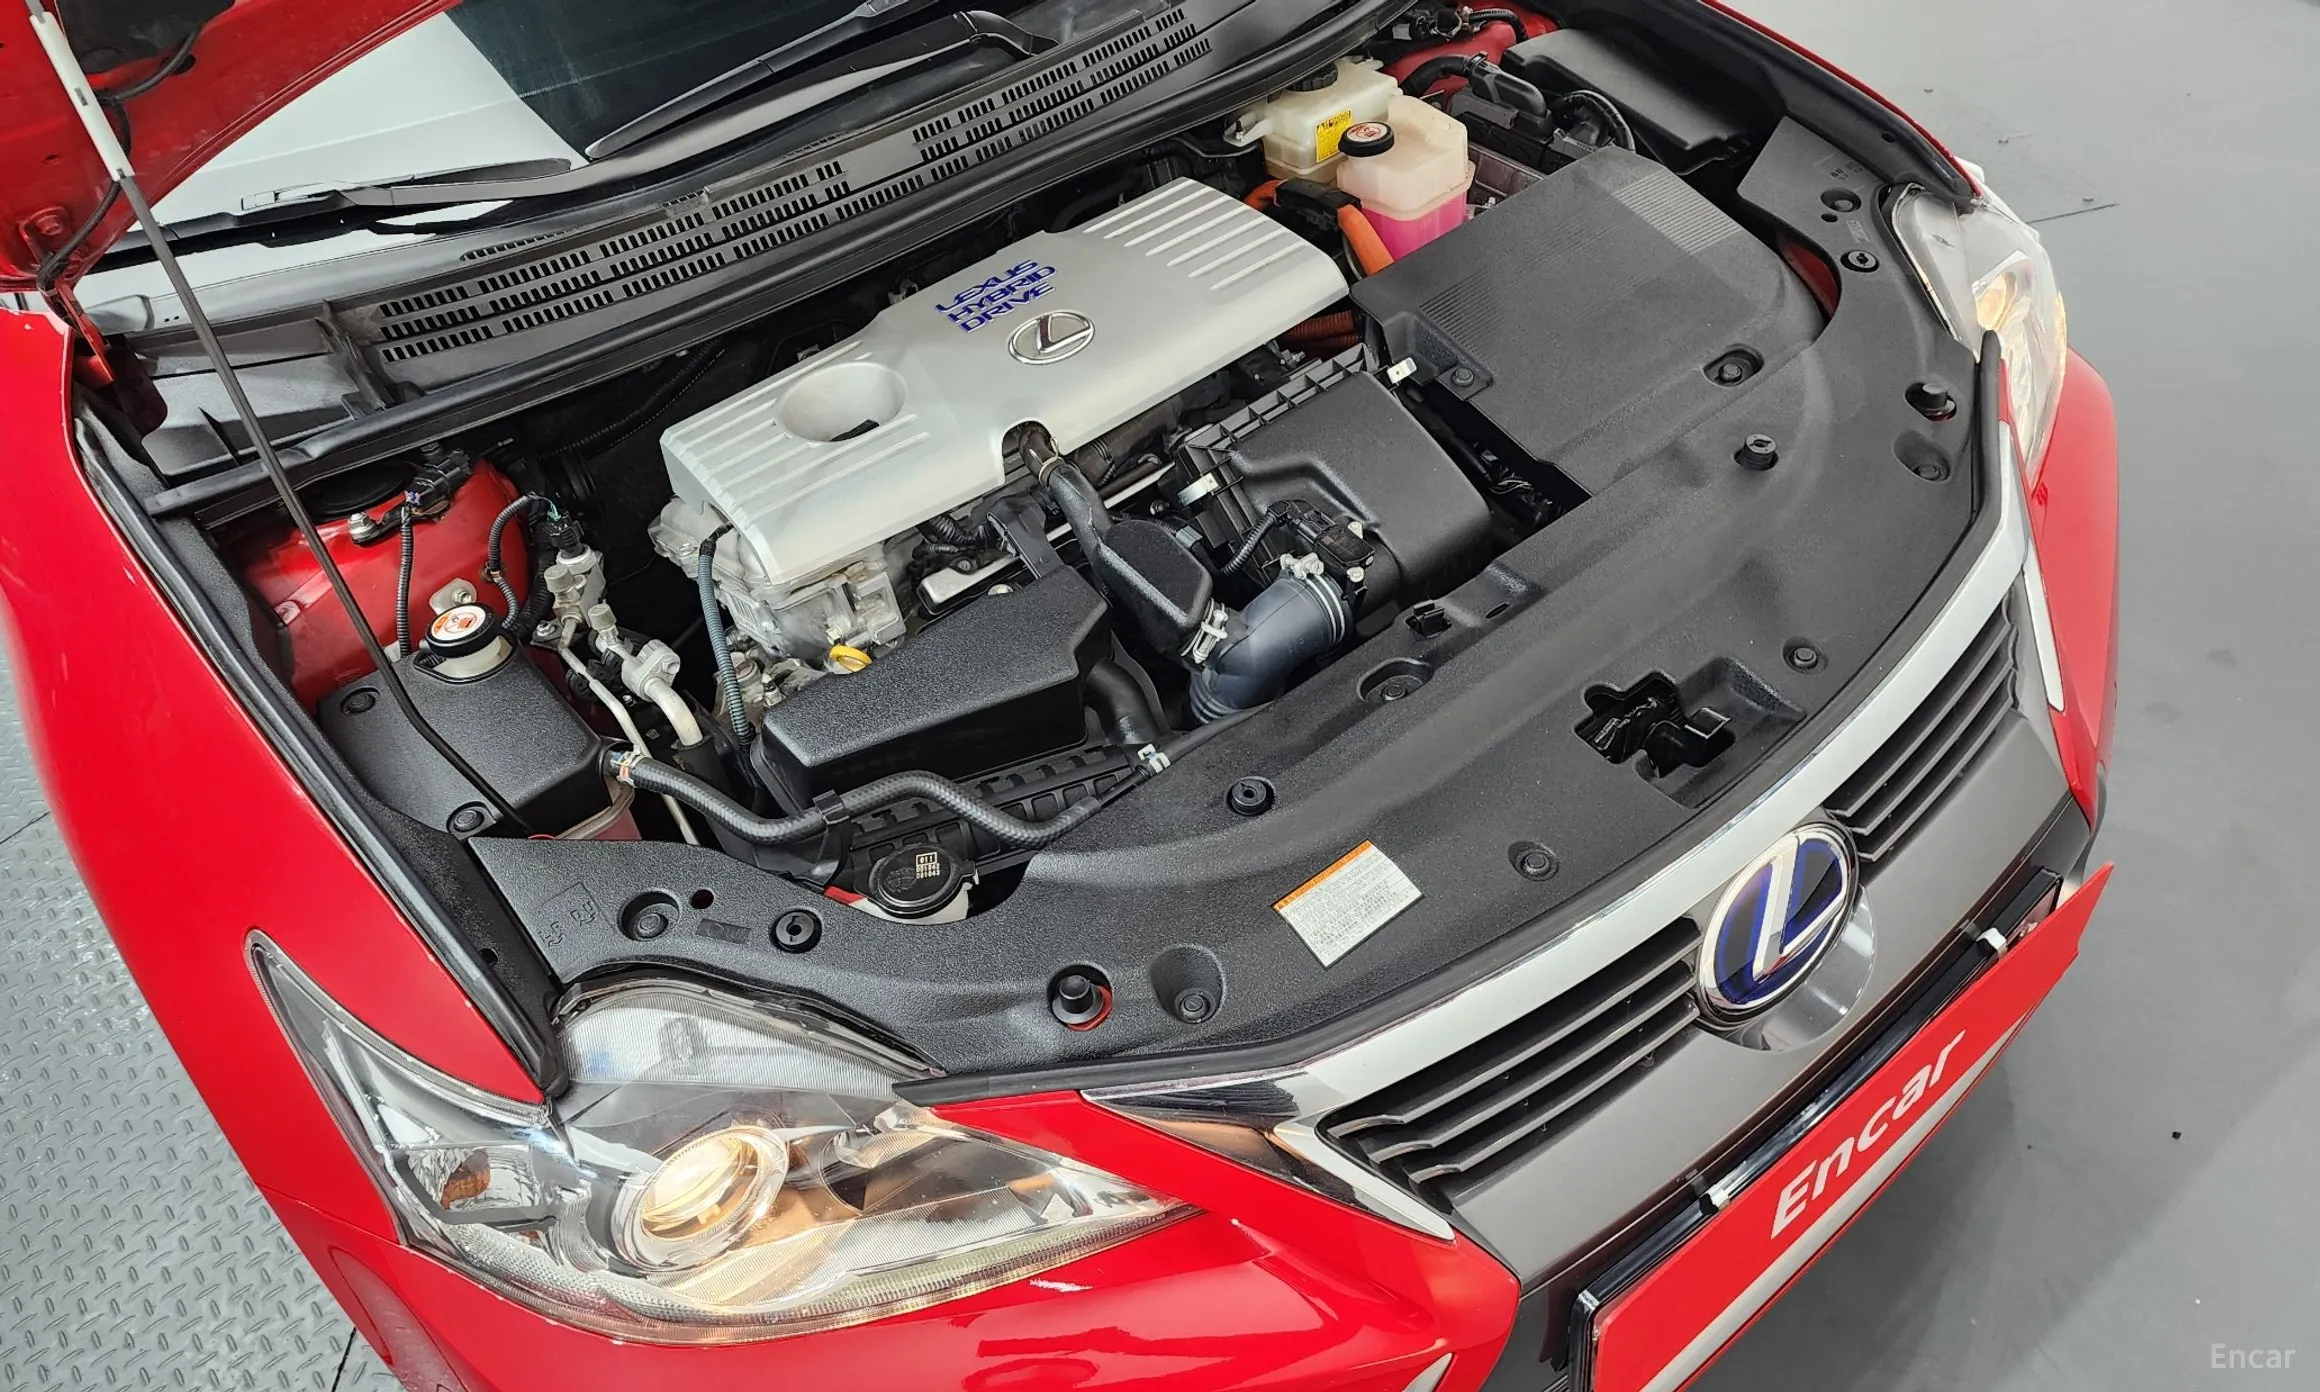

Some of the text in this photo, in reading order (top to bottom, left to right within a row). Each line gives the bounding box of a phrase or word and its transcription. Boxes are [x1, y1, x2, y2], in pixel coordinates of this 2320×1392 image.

[934, 259, 1039, 313] LEXUS
[947, 265, 1057, 323] HYBRID
[959, 280, 1056, 333] DRIVE
[1769, 1029, 1967, 1240] Encar
